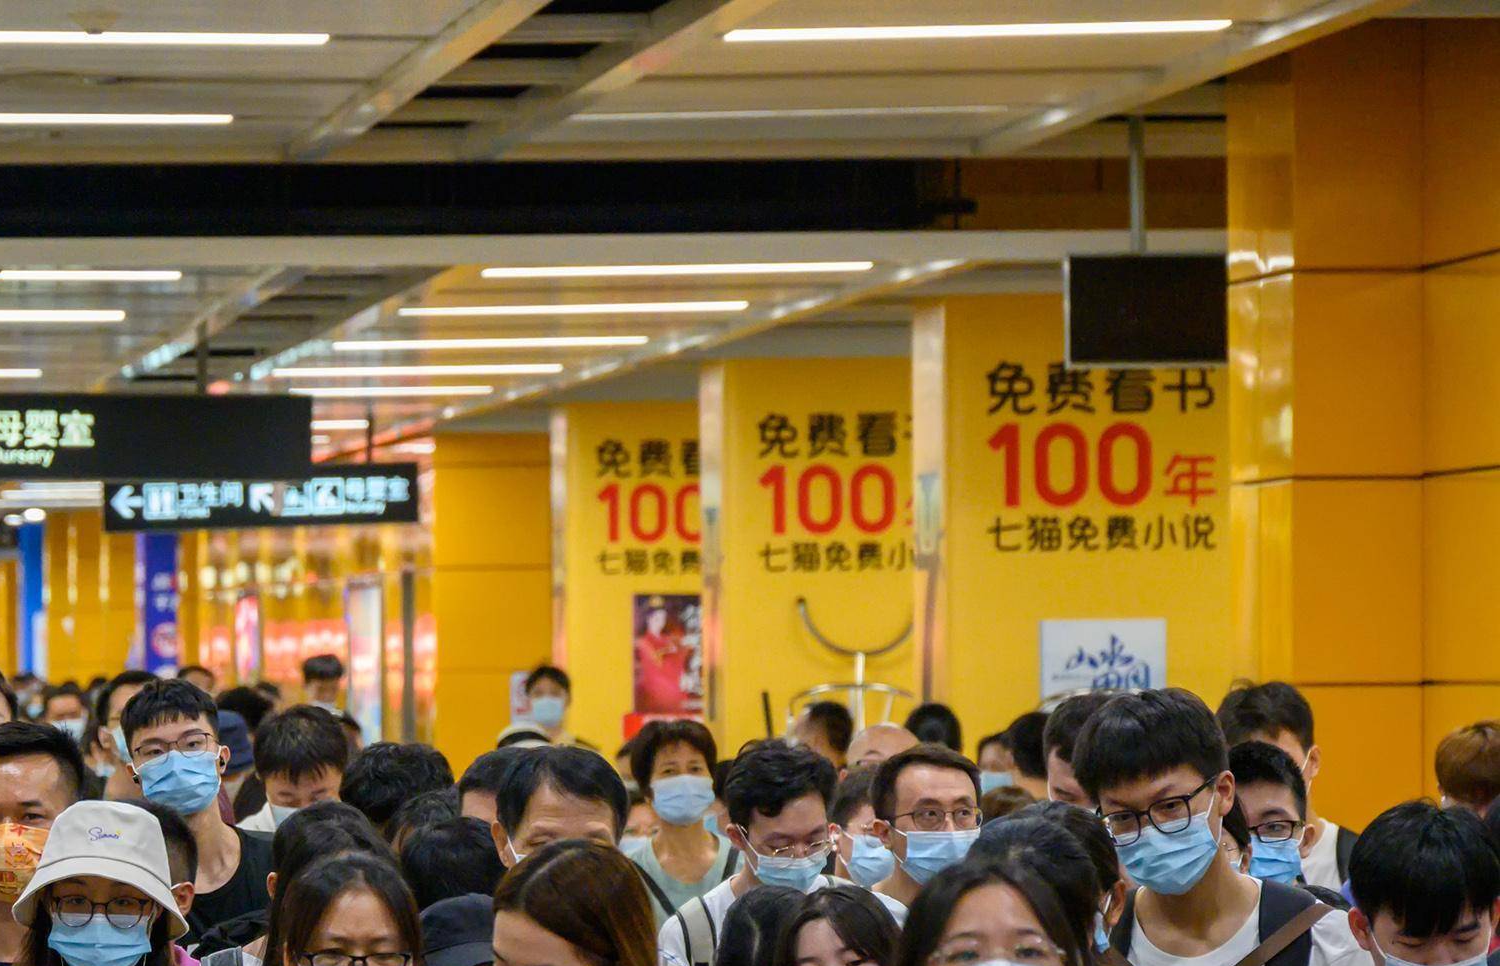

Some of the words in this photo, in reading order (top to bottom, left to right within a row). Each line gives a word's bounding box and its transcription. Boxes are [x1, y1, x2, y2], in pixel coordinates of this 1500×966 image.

[987, 361, 1216, 415] 免费看书
[758, 411, 913, 458] 免费看
[758, 463, 913, 536] 100
[987, 514, 1217, 552] 七猫免费小说
